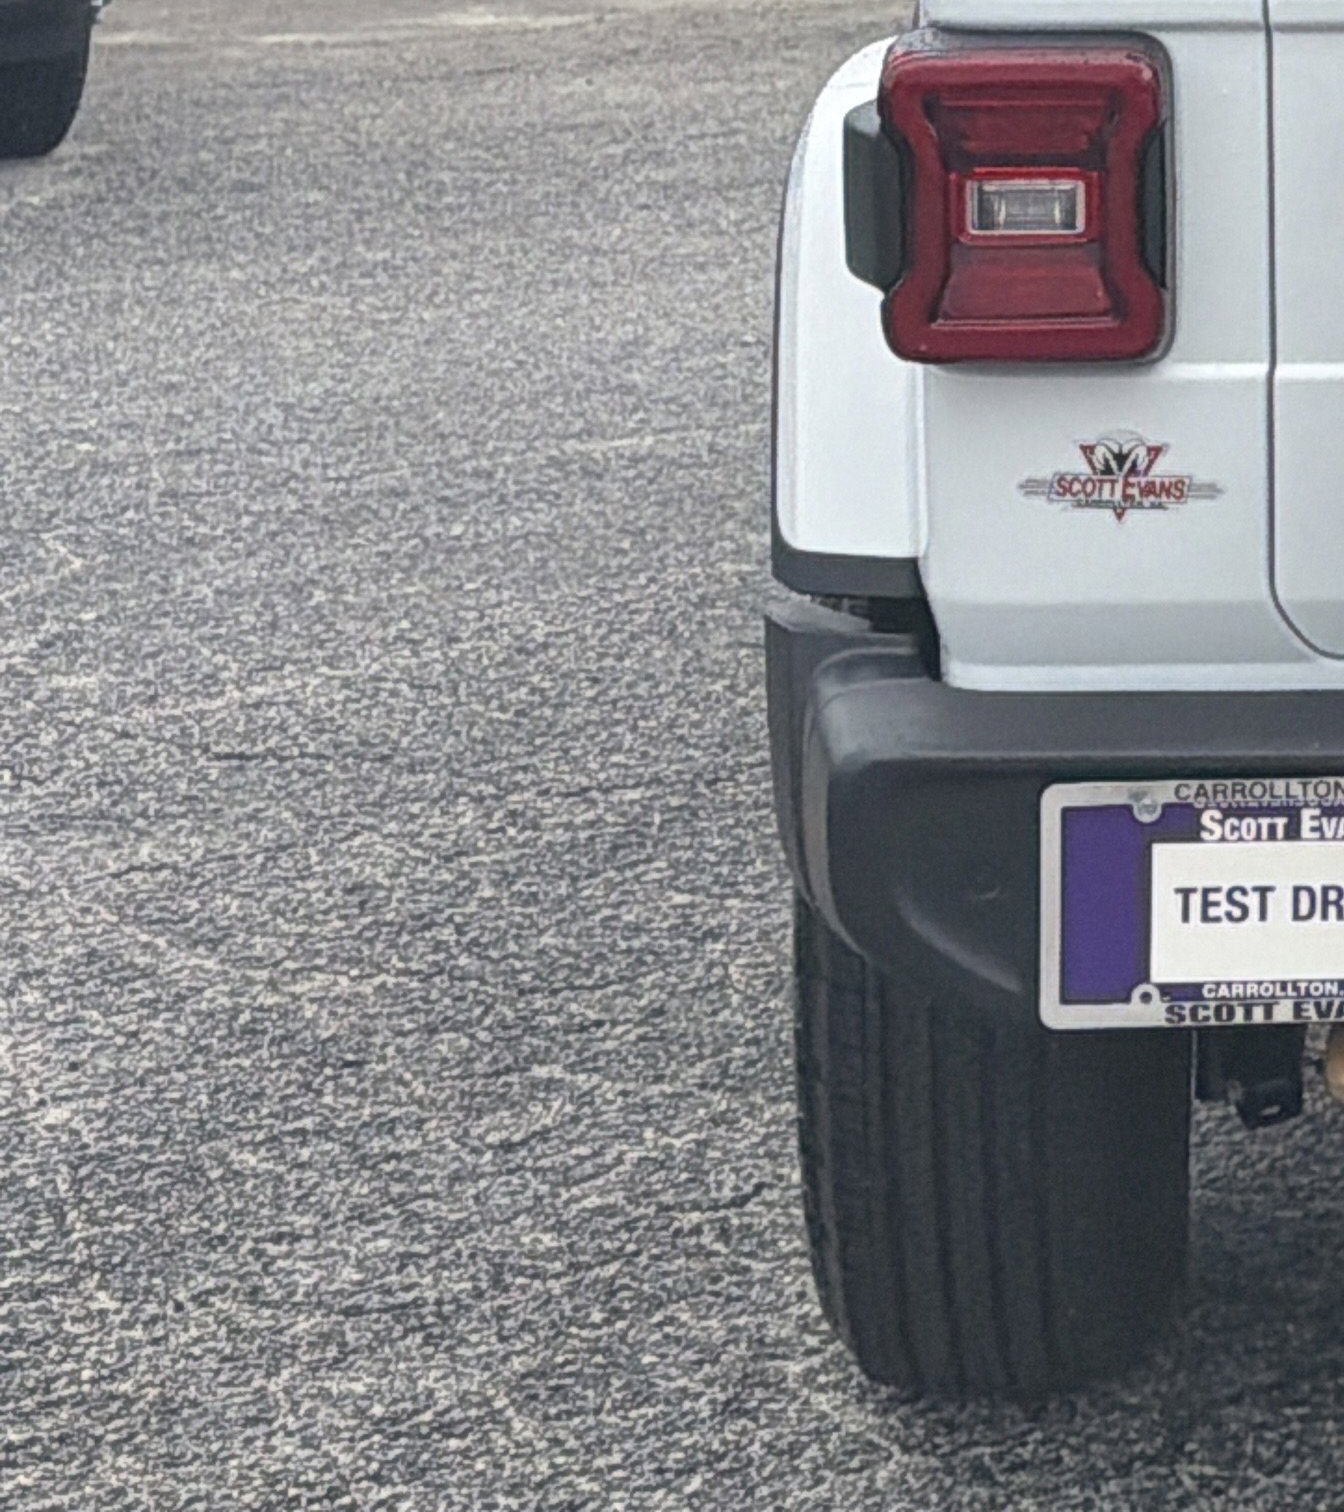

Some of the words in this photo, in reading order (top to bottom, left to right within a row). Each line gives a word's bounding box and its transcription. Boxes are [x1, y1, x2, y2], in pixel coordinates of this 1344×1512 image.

[1056, 476, 1118, 498] SCOTT
[1122, 469, 1186, 503] EVANS
[1175, 886, 1275, 923] TEST
[1164, 1001, 1279, 1024] SCOTT
